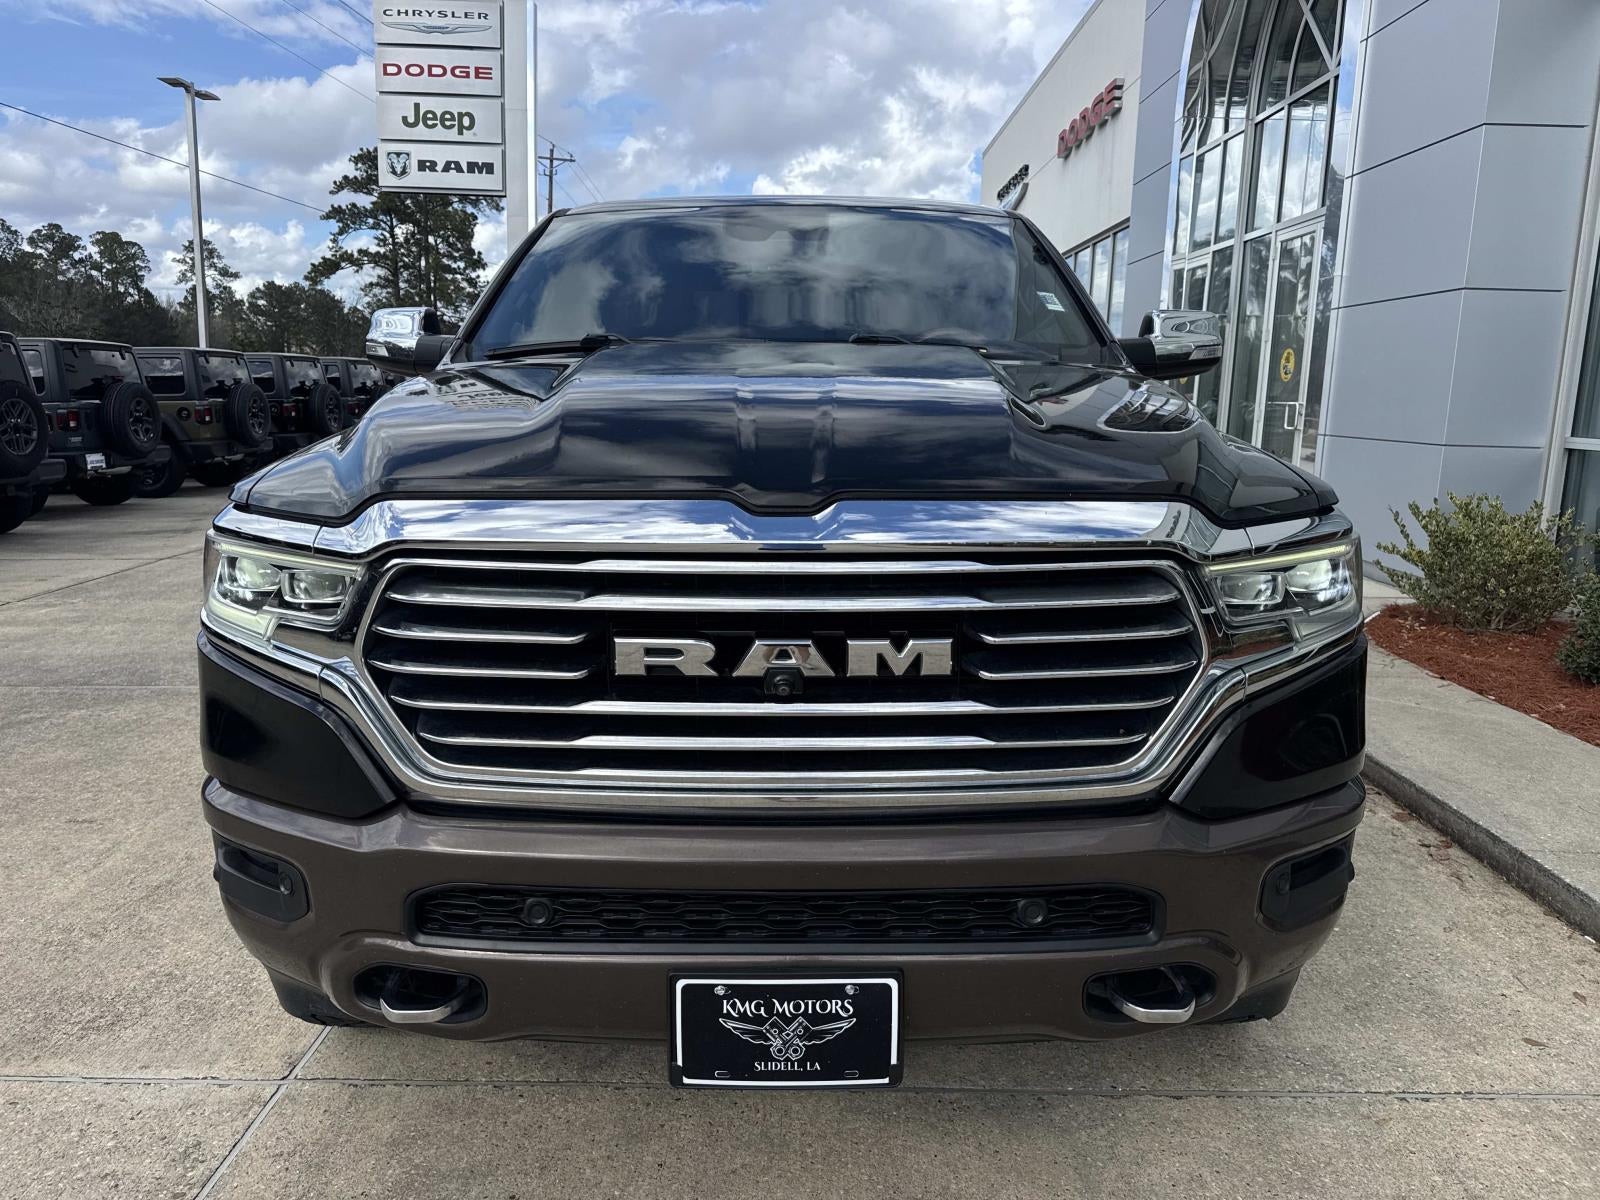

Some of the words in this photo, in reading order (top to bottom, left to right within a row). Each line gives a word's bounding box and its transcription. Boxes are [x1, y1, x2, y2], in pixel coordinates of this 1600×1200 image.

[382, 8, 489, 20] CHRYSLER
[382, 63, 493, 80] DODGE
[401, 102, 476, 136] Jeep
[1057, 77, 1125, 159] DODGE
[417, 159, 495, 175] RAM
[614, 637, 953, 677] RAM
[722, 998, 769, 1018] KMG
[773, 998, 854, 1018] MOTORS
[754, 1061, 803, 1072] SLIDELL,
[806, 1061, 821, 1071] LA
